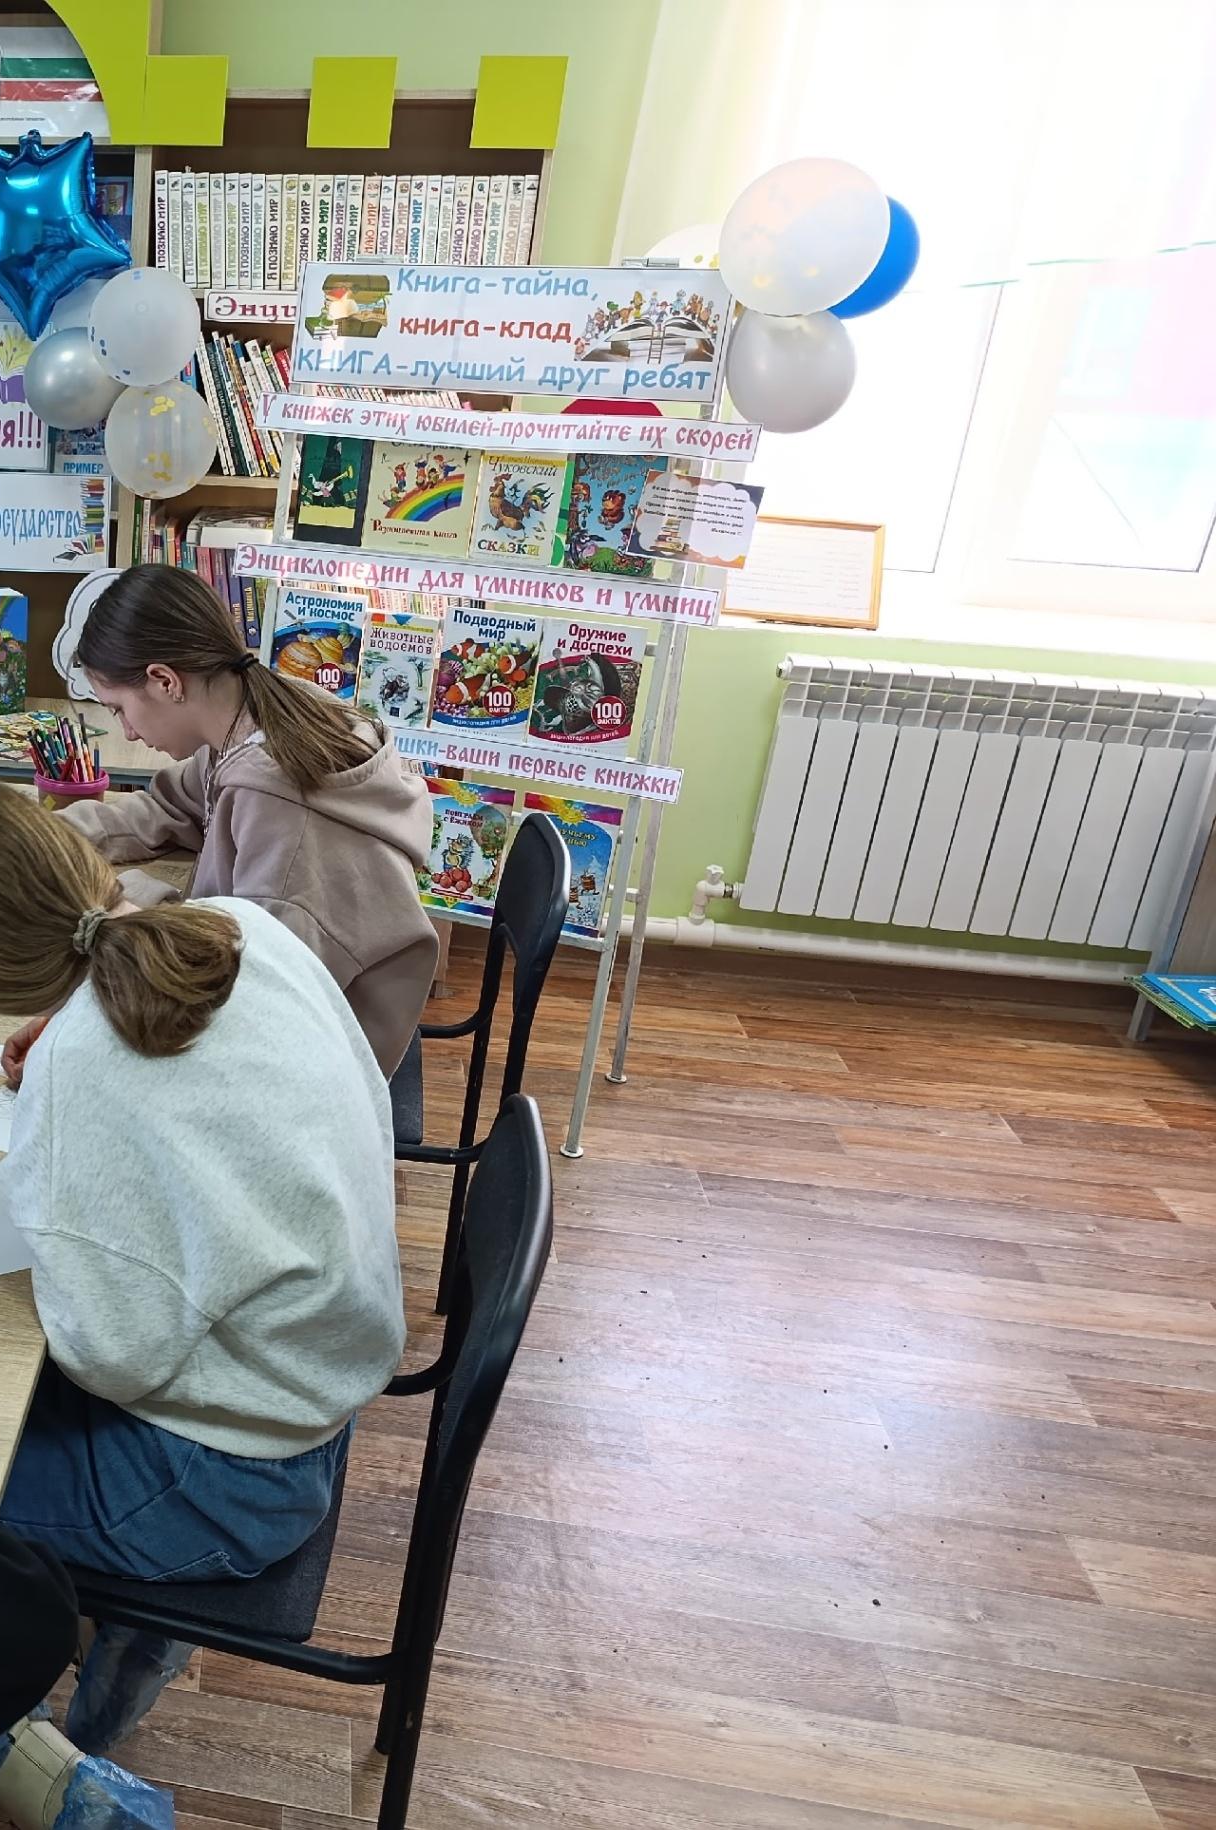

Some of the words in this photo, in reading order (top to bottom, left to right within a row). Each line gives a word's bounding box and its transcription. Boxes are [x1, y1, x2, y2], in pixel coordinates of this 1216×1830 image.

[157, 197, 166, 219] МИР
[241, 202, 250, 223] МИР
[270, 199, 278, 222] МИР
[301, 200, 310, 224] МИР
[319, 199, 329, 224] МИР
[336, 202, 344, 224] МИР
[350, 204, 358, 226] МИР
[368, 203, 377, 226] МИР
[382, 206, 391, 228] МИР
[412, 199, 423, 224] МИР
[456, 200, 467, 224] МИР
[473, 202, 484, 226] МИР
[269, 225, 278, 270] ПОЗНАЮ
[317, 226, 328, 261] ОЗНАЮ
[333, 228, 342, 261] ОЗНАЮ
[409, 227, 420, 264] ОЗНАЮ
[452, 228, 464, 265] ОЗНАЮ
[469, 229, 482, 265] ОЗНАЮ
[486, 230, 498, 265] ОЗНАЮ
[267, 272, 277, 280] Я
[397, 268, 600, 302] Книга-тайна,
[298, 346, 526, 386] КНИГА-лучший
[537, 365, 613, 392] друг
[622, 363, 712, 391] ребят
[262, 393, 277, 424] У
[281, 402, 355, 425] книжек
[359, 409, 410, 436] этих
[416, 414, 633, 445] юбилей-прочитайте
[639, 425, 668, 449] их
[675, 425, 754, 455] скорей
[64, 462, 104, 474] ПРИМЕР
[488, 455, 558, 477] Чуковский
[477, 538, 540, 557] СКАЗКИ
[237, 545, 410, 587] Энциклопедии
[417, 569, 465, 592] для
[474, 574, 585, 605] умников
[595, 588, 612, 606] и
[624, 590, 713, 626] умниц
[285, 591, 363, 613] Астрономия
[297, 606, 306, 615] и
[309, 608, 355, 622] космос
[453, 609, 536, 632] Подводный
[369, 627, 434, 646] Животные
[478, 628, 506, 642] мир
[568, 623, 627, 643] Оружие
[557, 638, 566, 649] и
[569, 640, 633, 657] доспехи
[317, 668, 341, 684] 100
[486, 691, 512, 707] 100
[595, 702, 622, 719] 100
[508, 753, 587, 782] первые
[594, 766, 677, 796] книжки
